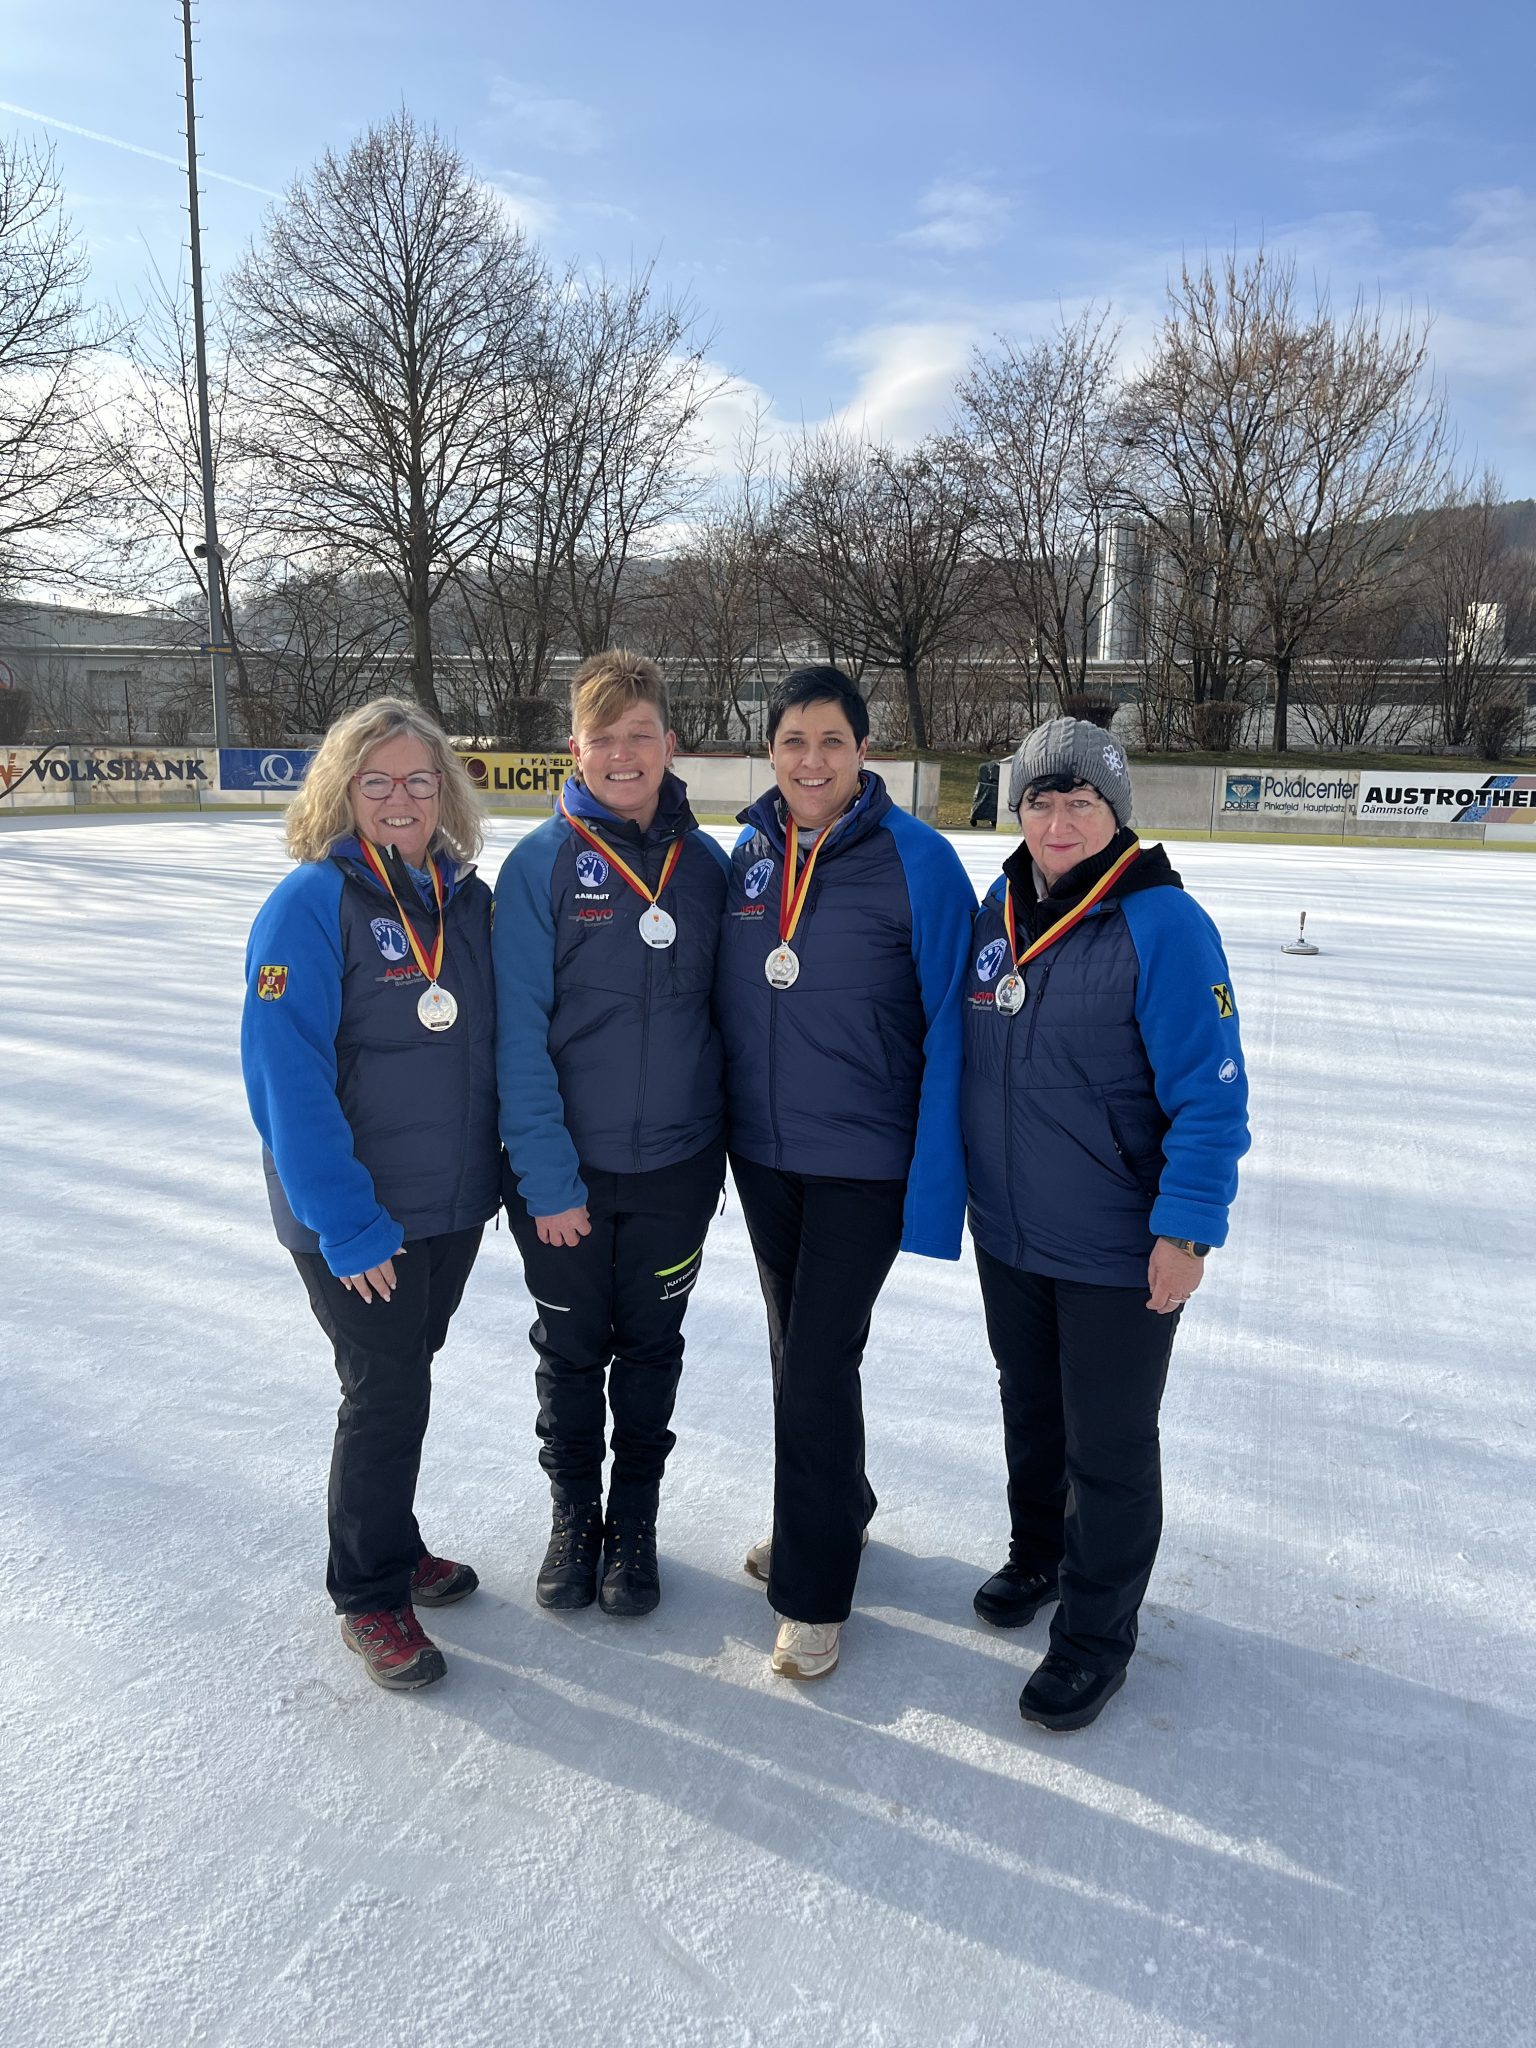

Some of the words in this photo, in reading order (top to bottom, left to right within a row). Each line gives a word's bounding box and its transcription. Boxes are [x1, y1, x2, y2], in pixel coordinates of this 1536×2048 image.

[30, 759, 207, 781] VOLKSBANK
[494, 768, 563, 791] LICHT
[1264, 776, 1359, 800] Pokalcenter
[1361, 804, 1429, 816] Dämmstoffe
